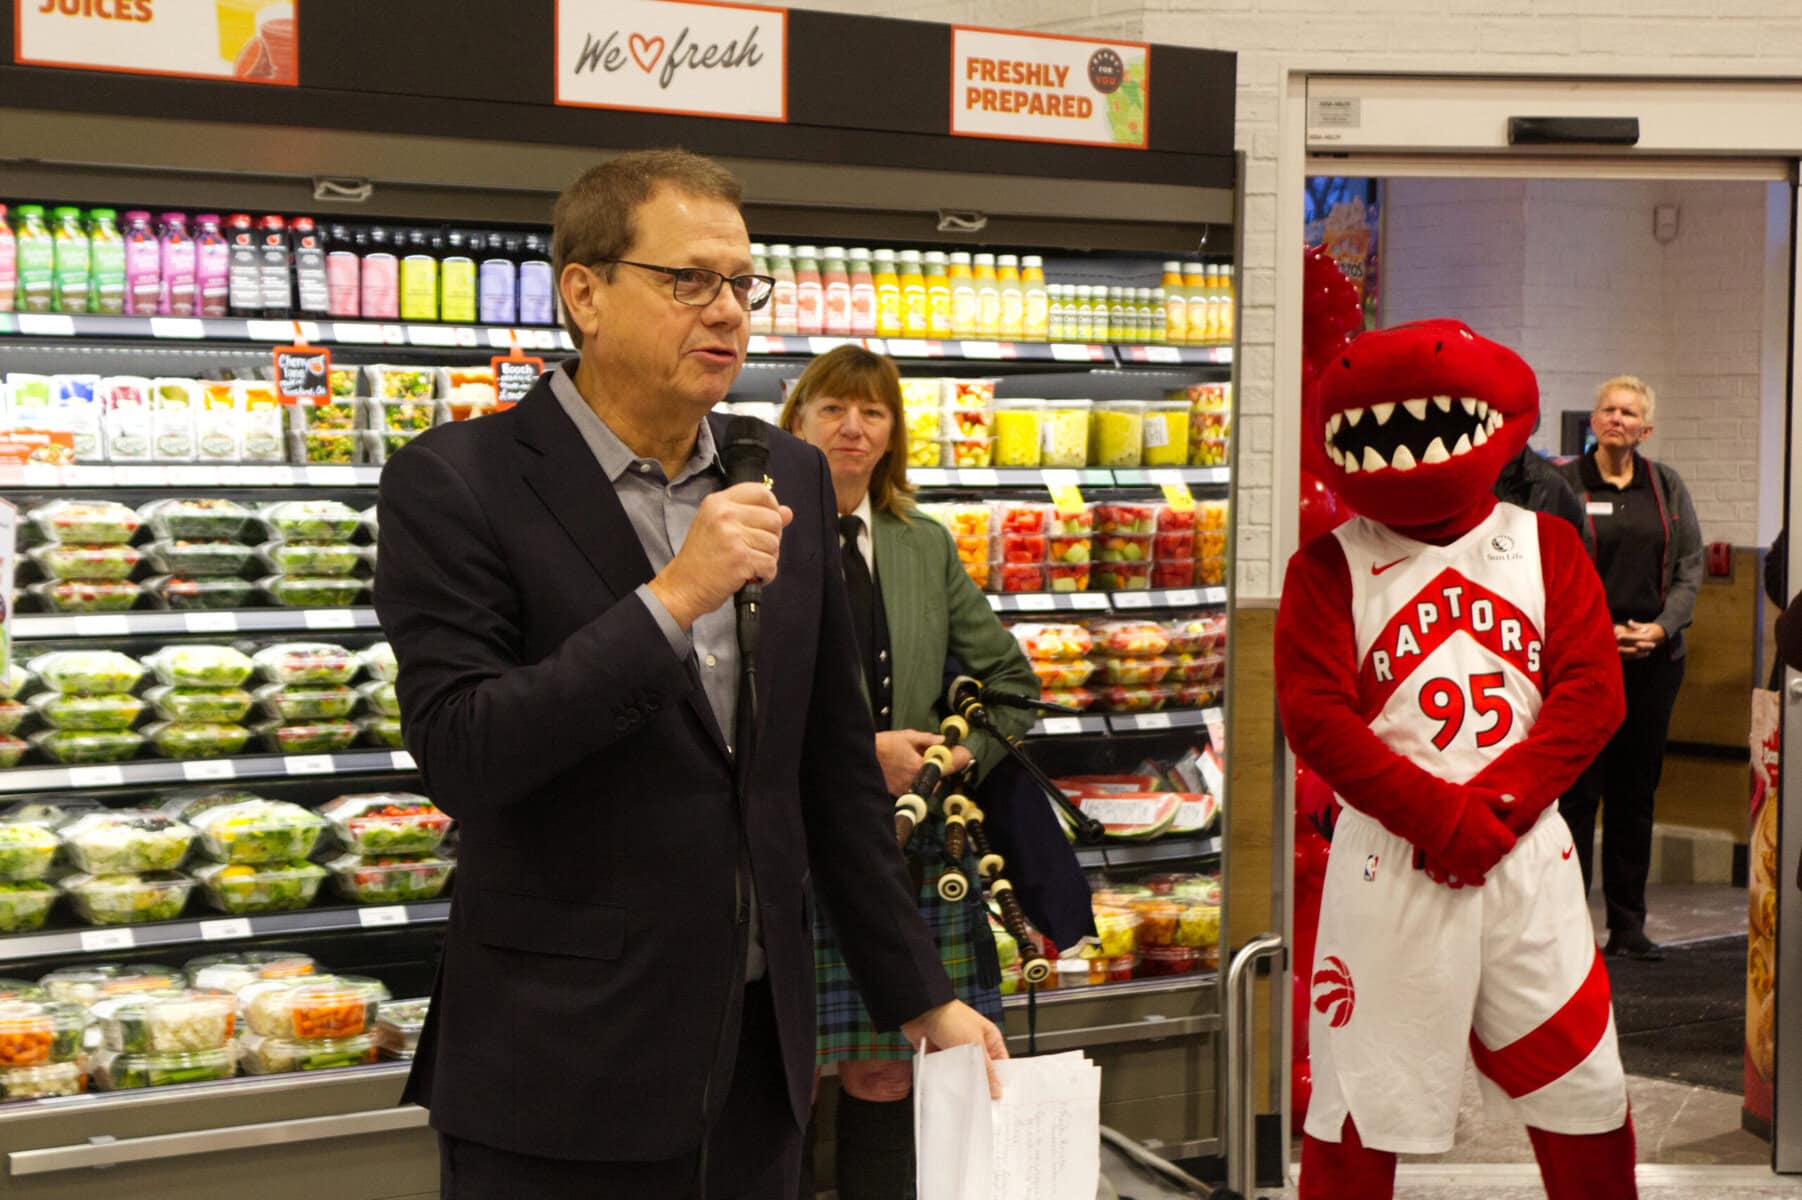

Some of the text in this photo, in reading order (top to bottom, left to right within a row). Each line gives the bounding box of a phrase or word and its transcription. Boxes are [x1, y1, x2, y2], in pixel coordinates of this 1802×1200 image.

[574, 25, 763, 89] We fresh
[966, 57, 1070, 88] FRESHLY
[966, 87, 1092, 119] PREPARED
[1373, 586, 1541, 682] RAPTORS
[1418, 671, 1513, 751] 95
